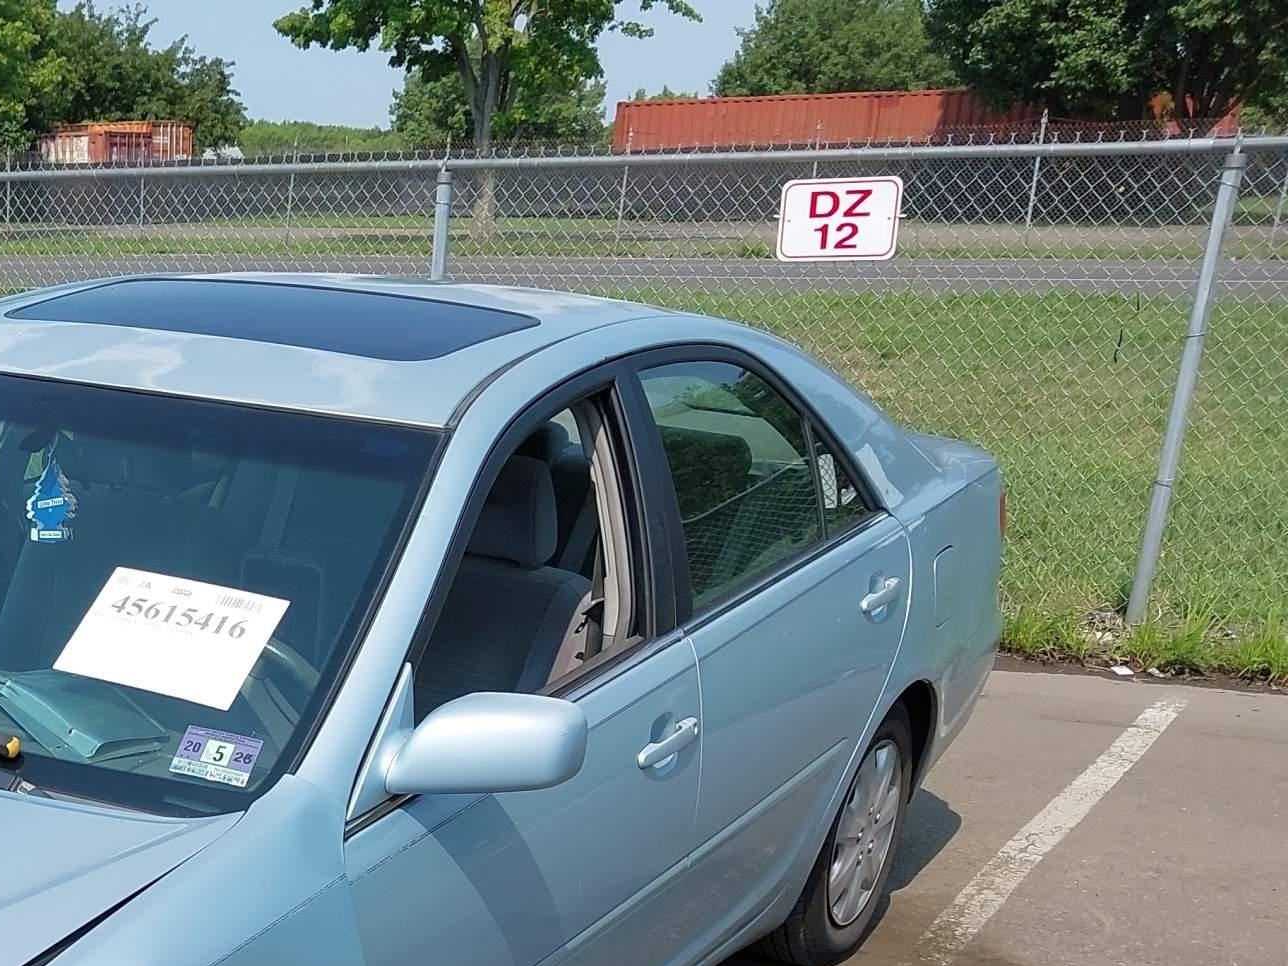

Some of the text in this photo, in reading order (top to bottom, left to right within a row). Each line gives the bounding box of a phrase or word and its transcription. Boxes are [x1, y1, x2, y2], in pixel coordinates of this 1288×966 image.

[809, 189, 873, 218] DZ
[813, 222, 859, 250] 12
[111, 595, 249, 639] 45615416
[183, 740, 202, 753] 20
[212, 745, 226, 762] 5
